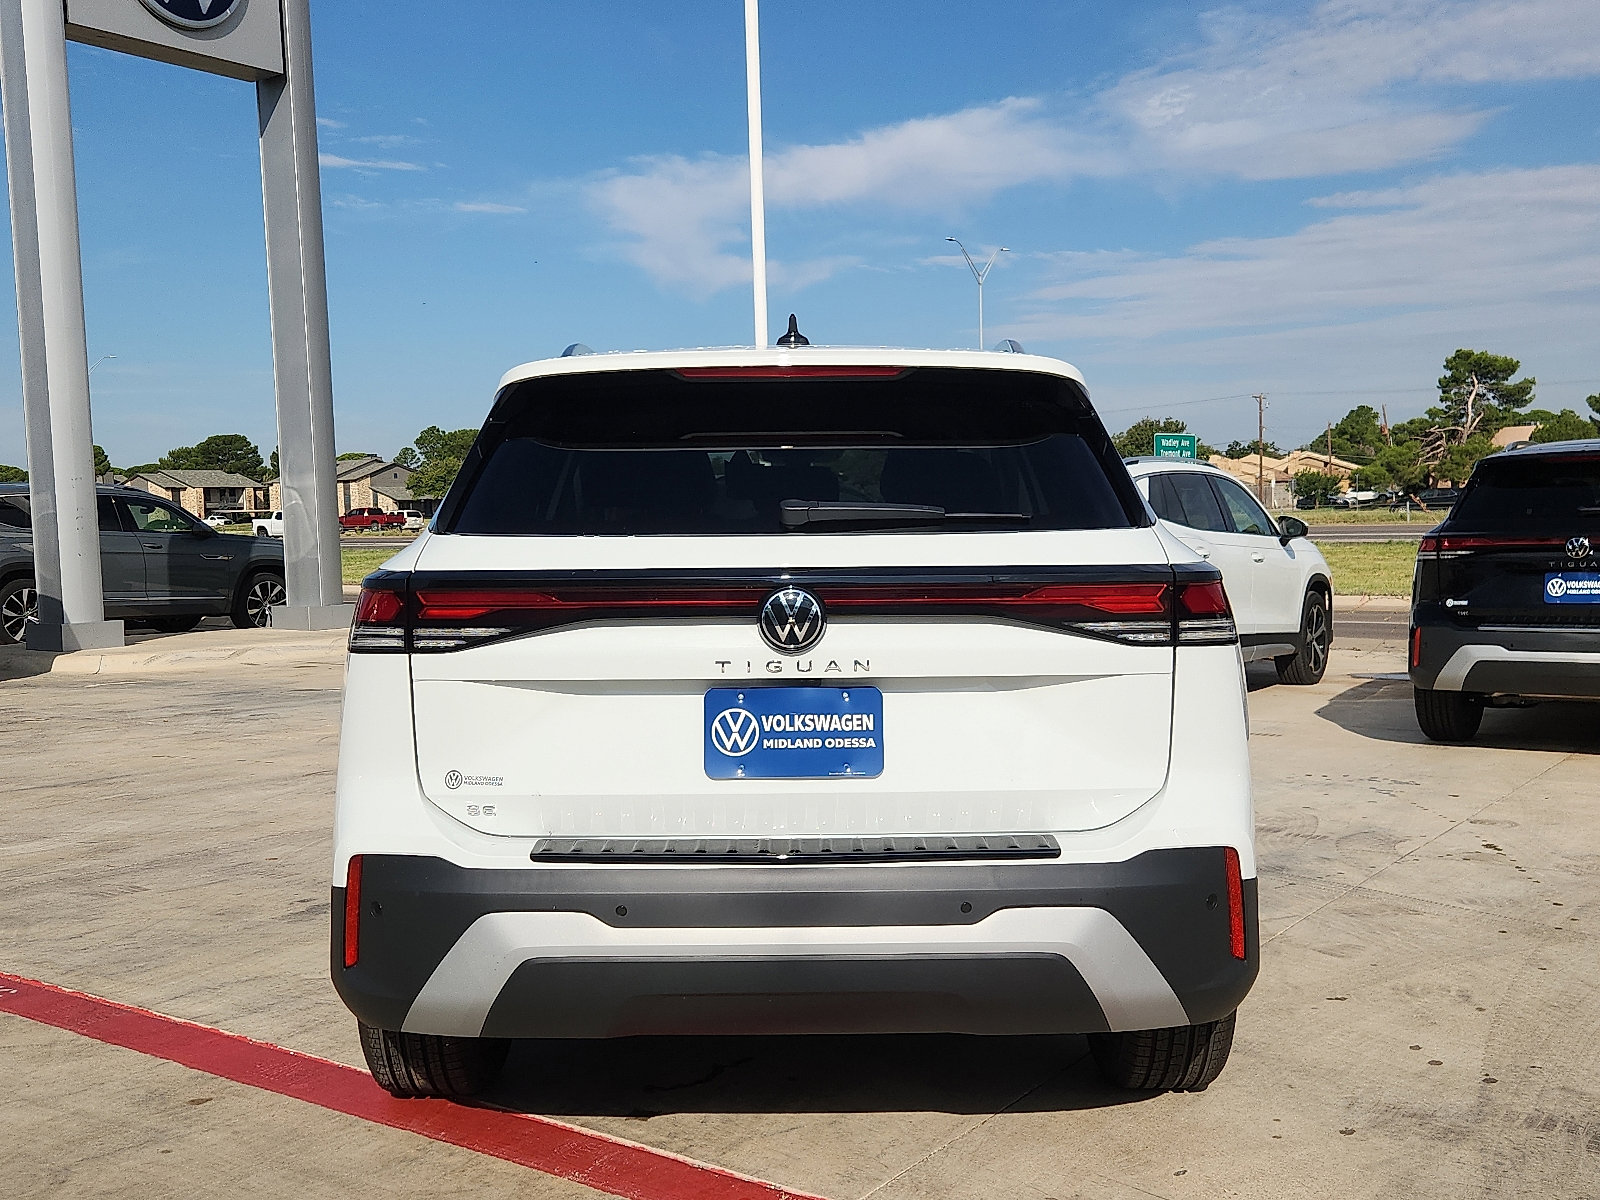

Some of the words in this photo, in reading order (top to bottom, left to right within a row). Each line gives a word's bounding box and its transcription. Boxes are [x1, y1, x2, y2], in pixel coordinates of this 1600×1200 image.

[1161, 439, 1179, 448] Wadley
[1181, 439, 1190, 447] Ave
[1160, 449, 1180, 458] Tremont
[1182, 449, 1191, 458] Ave
[762, 590, 822, 649] VW
[715, 660, 871, 673] TIGUAN
[761, 714, 875, 732] VOLKSWAGEN
[711, 708, 760, 757] VW
[763, 738, 823, 749] MIDLAND
[824, 738, 877, 749] ODESSA
[466, 804, 497, 817] SE
